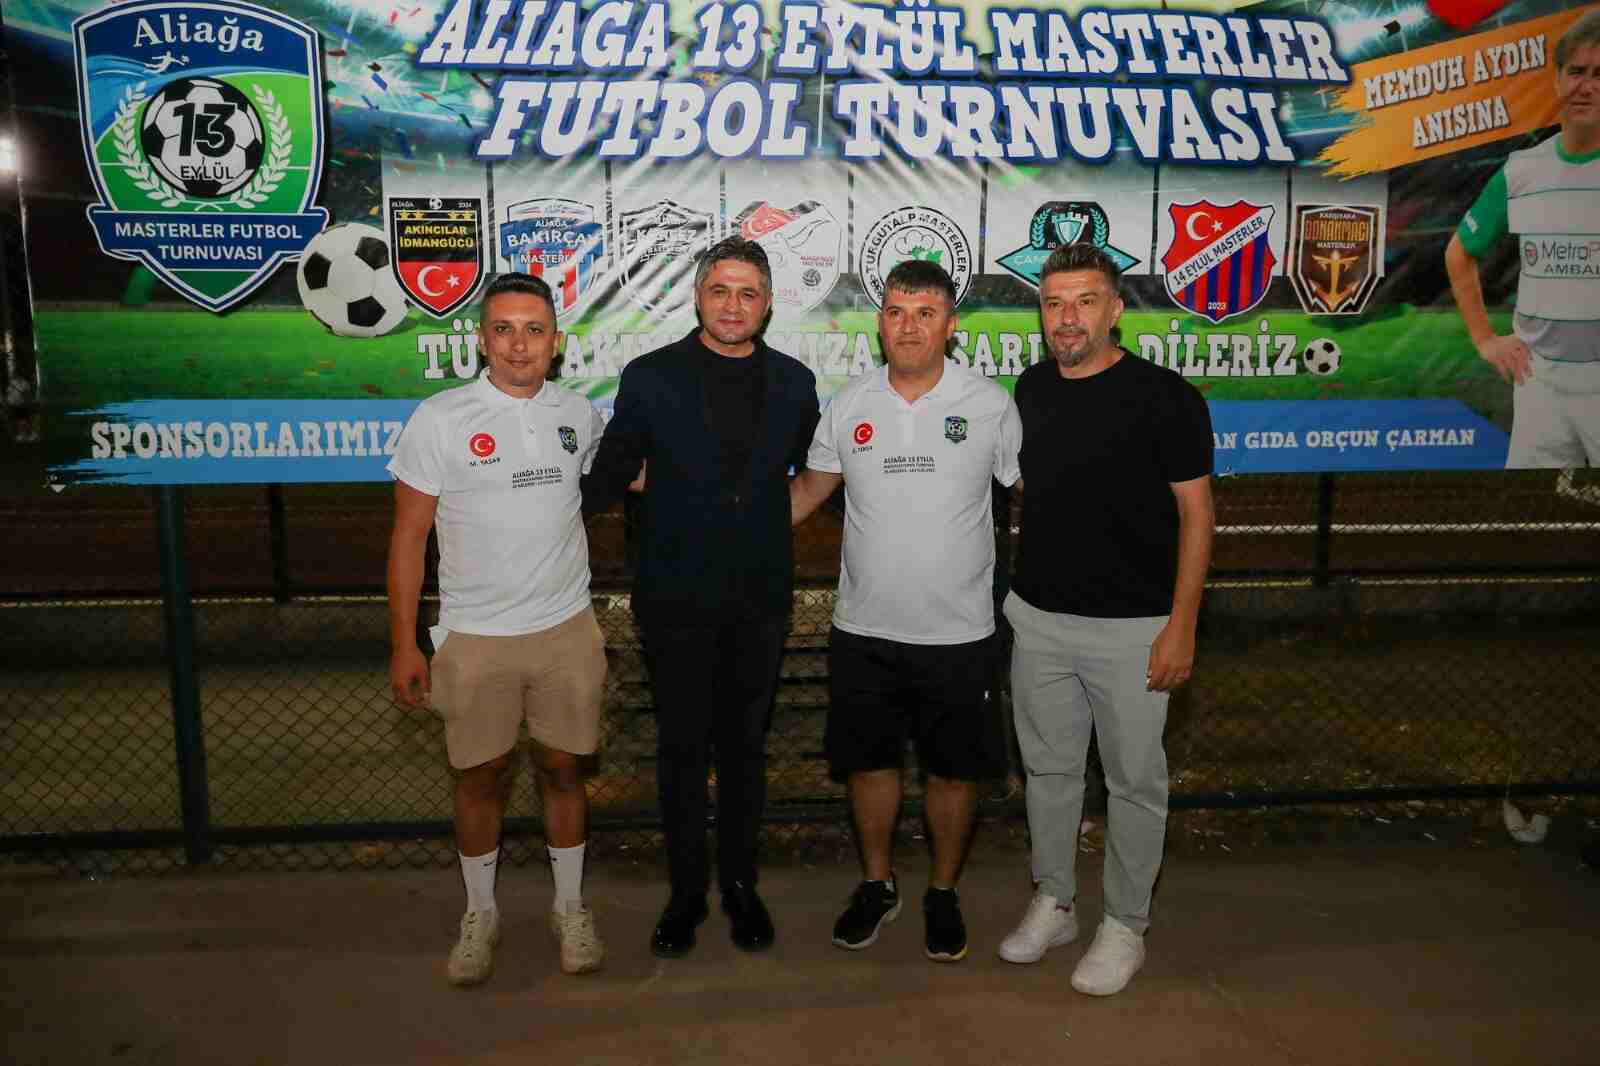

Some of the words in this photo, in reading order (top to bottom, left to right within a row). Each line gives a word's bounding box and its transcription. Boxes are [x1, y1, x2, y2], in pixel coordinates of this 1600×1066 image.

[133, 14, 264, 53] Aliağa
[695, 3, 760, 68] 13
[992, 11, 1351, 82] MASTERLER
[1361, 55, 1466, 110] MEMDUH
[1473, 34, 1546, 83] AYDIN
[172, 102, 236, 157] 13
[477, 80, 806, 157] FUTBOL
[837, 84, 1296, 162] TURNUVASI
[1412, 95, 1510, 148] ANISINA
[180, 161, 235, 181] EYLÜL
[115, 222, 226, 239] MASTERLER
[229, 223, 303, 240] FUTBOL
[404, 225, 467, 235] AKINCILAR
[866, 213, 917, 274] TURGUTALP
[919, 214, 967, 273] MASTERLER
[1211, 216, 1265, 257] MASTERLER
[158, 245, 263, 261] TURNUVASI
[90, 421, 403, 459] SPONSORLARIMIZ
[1244, 432, 1298, 449] GIDA
[1305, 430, 1379, 451] ORÇUN
[1386, 429, 1475, 451] ÇARMAN
